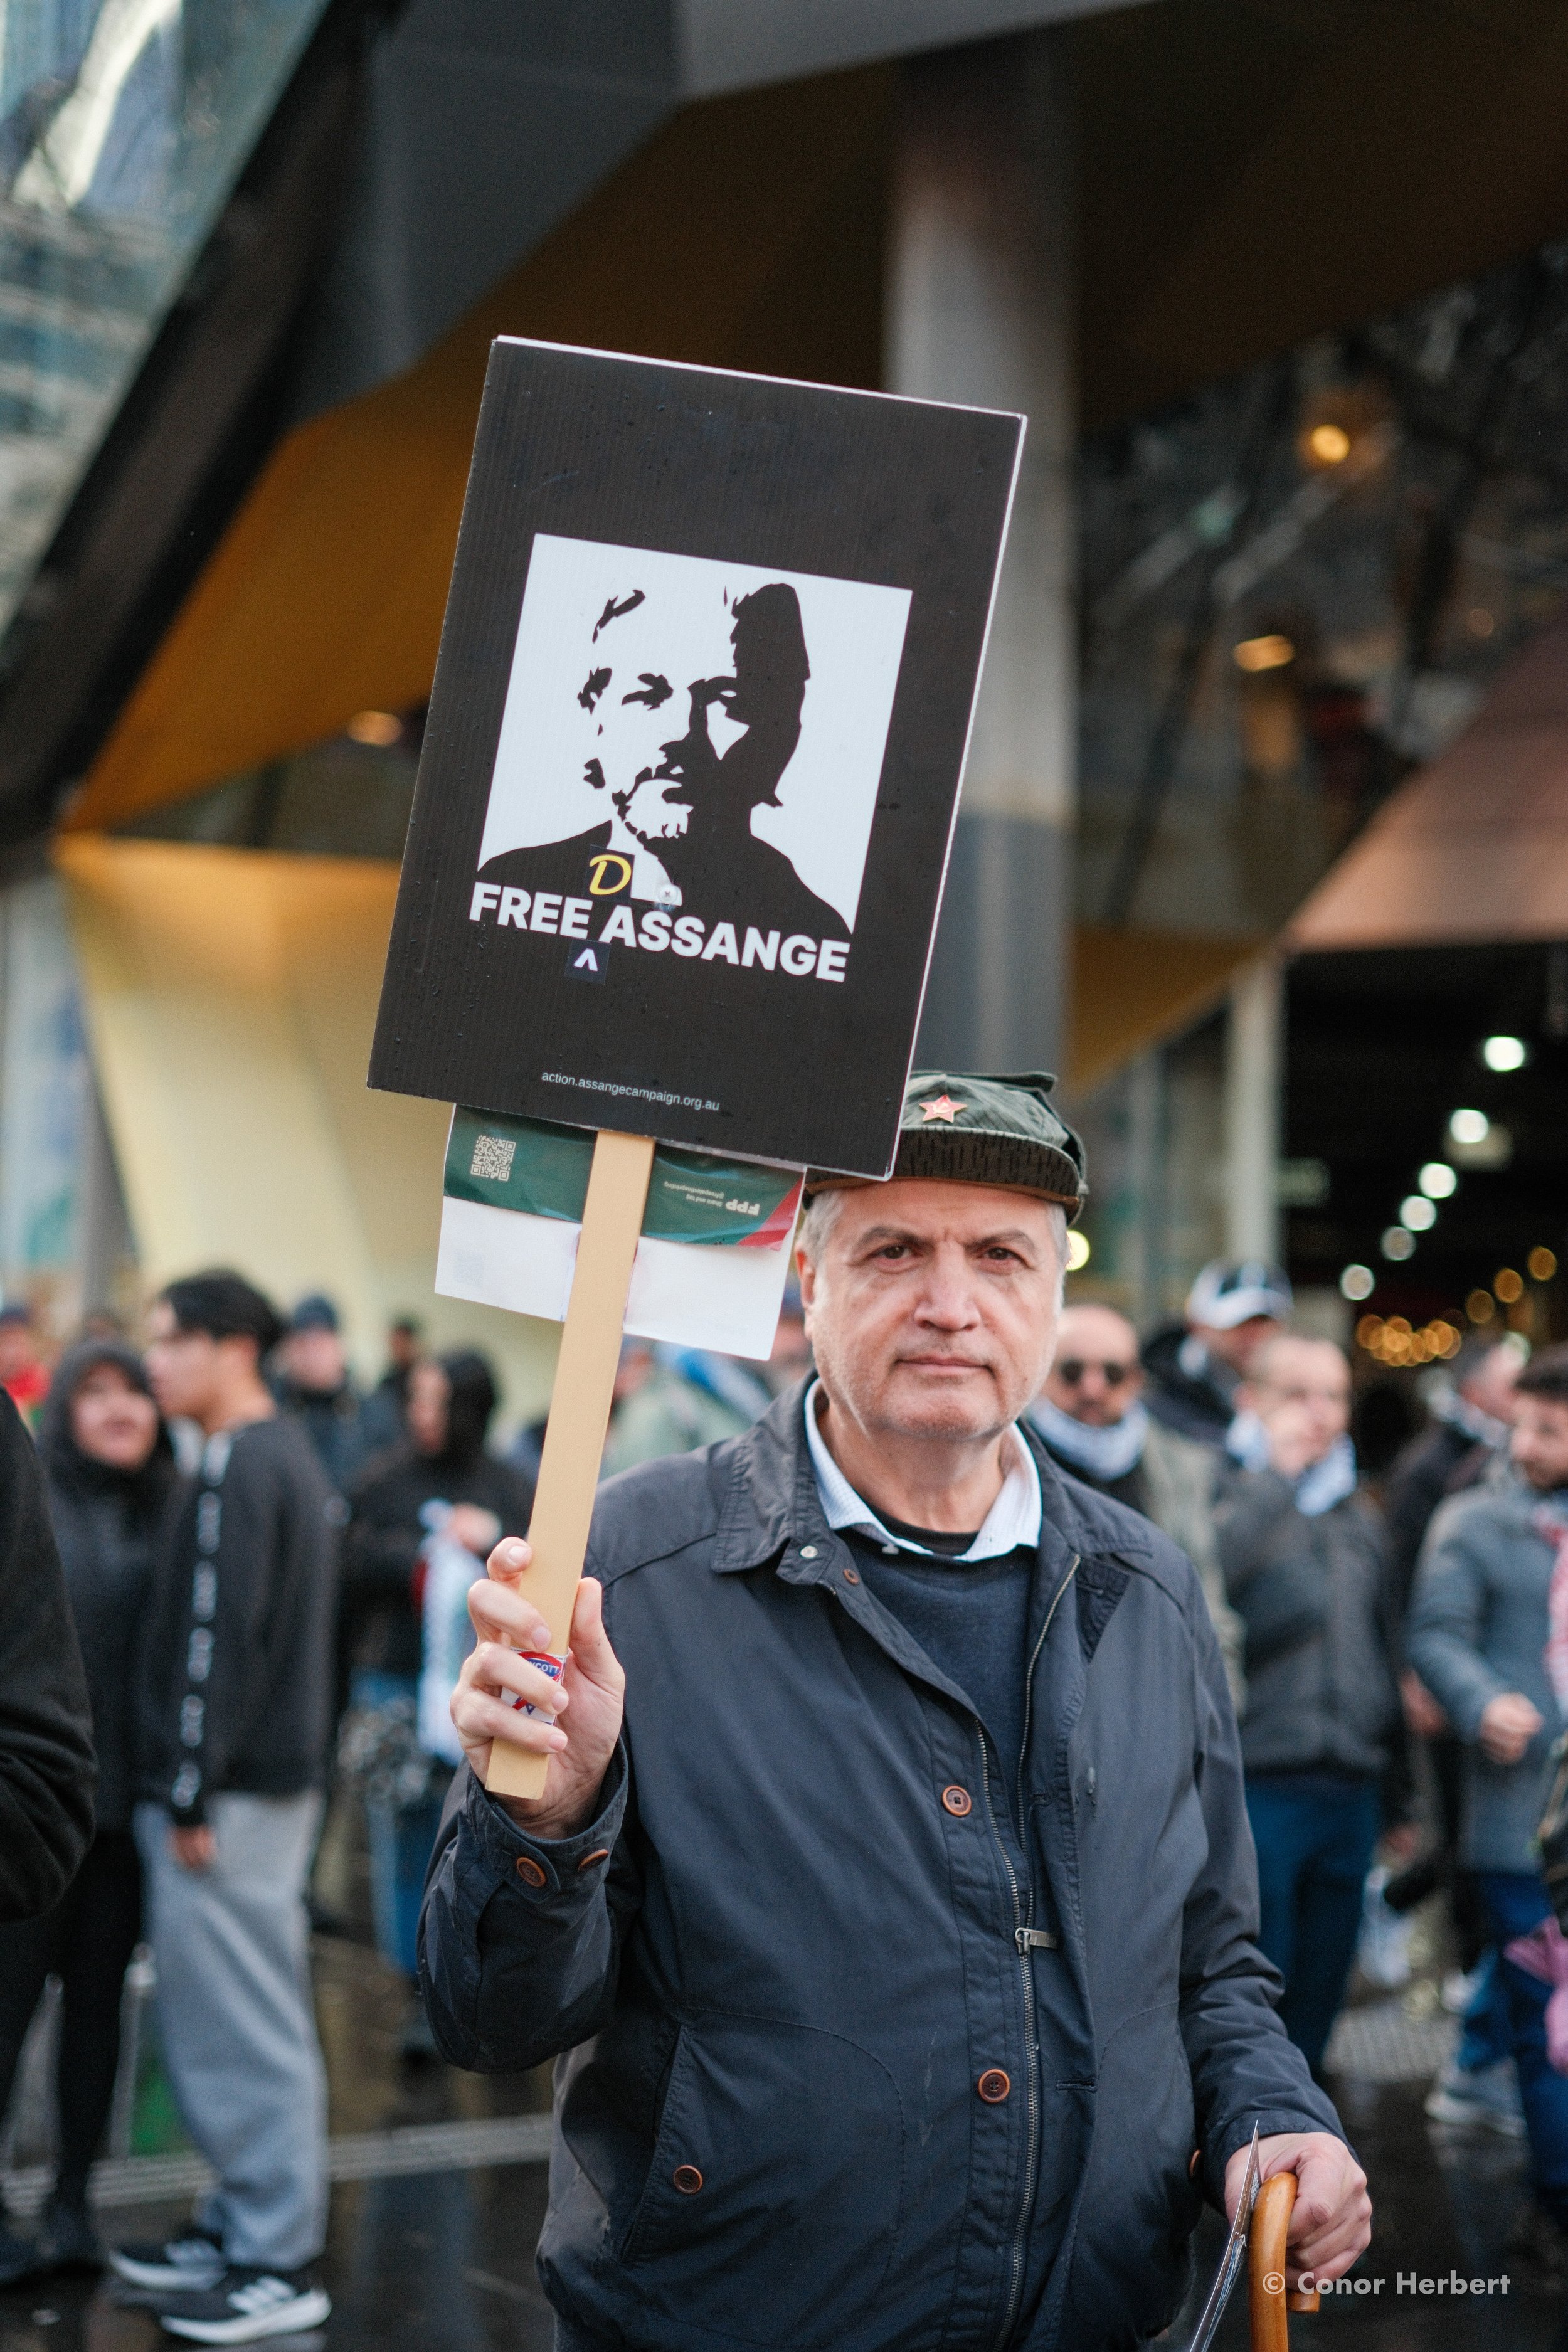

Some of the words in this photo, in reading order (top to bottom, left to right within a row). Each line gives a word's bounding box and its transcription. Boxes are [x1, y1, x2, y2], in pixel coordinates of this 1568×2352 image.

[589, 854, 632, 895] D
[469, 881, 593, 940] FREE
[598, 904, 850, 983] ASSANGE
[541, 1071, 720, 1111] action.assangecampaign.org.au
[725, 1199, 761, 1216] FPP
[531, 1661, 559, 1674] COTT
